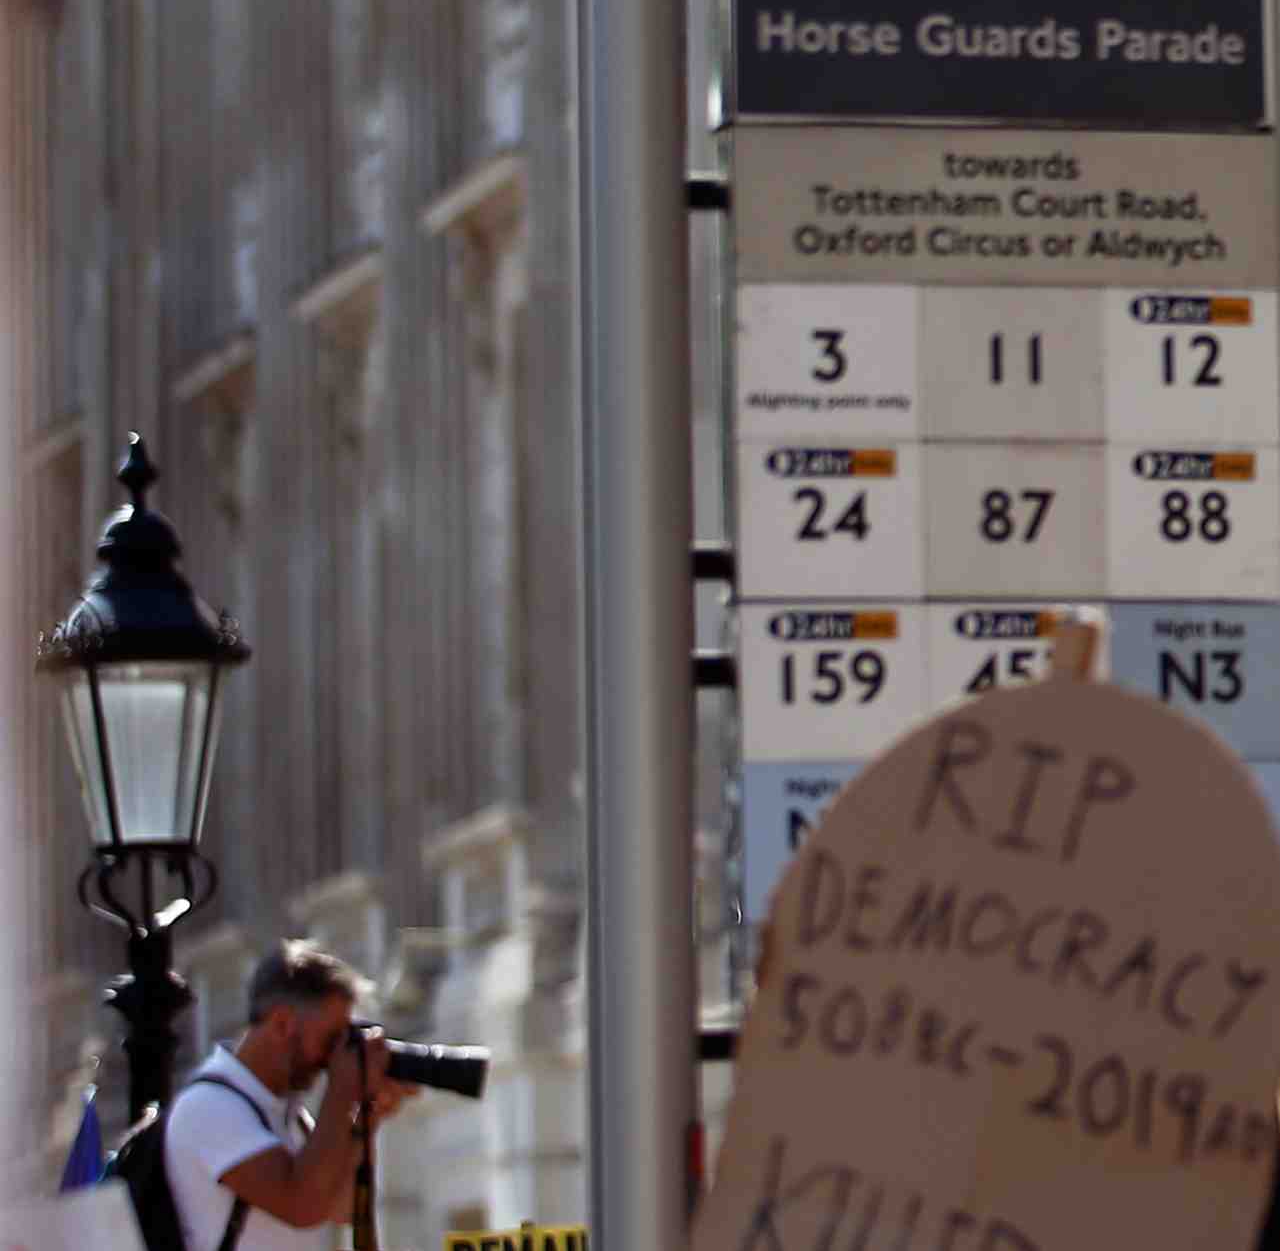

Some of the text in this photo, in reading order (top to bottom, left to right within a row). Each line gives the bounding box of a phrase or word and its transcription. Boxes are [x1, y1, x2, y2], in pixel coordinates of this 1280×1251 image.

[756, 13, 1245, 65] Horse Guards Parade
[945, 152, 1080, 180] towards
[811, 186, 1001, 218] Tottenham
[1012, 189, 1106, 219] Court
[794, 226, 1226, 265] Oxford Circus or Aldwych
[811, 329, 848, 383] 3
[988, 333, 1041, 384] 11
[1162, 335, 1223, 386] 12
[794, 488, 870, 541] 24
[980, 490, 1054, 543] 87
[1160, 491, 1231, 543] 88
[781, 652, 886, 704] 159
[965, 649, 1055, 694] 45
[1160, 651, 1244, 704] N3
[917, 719, 1135, 861] RIP
[799, 853, 1267, 1038] DEMOCRACY
